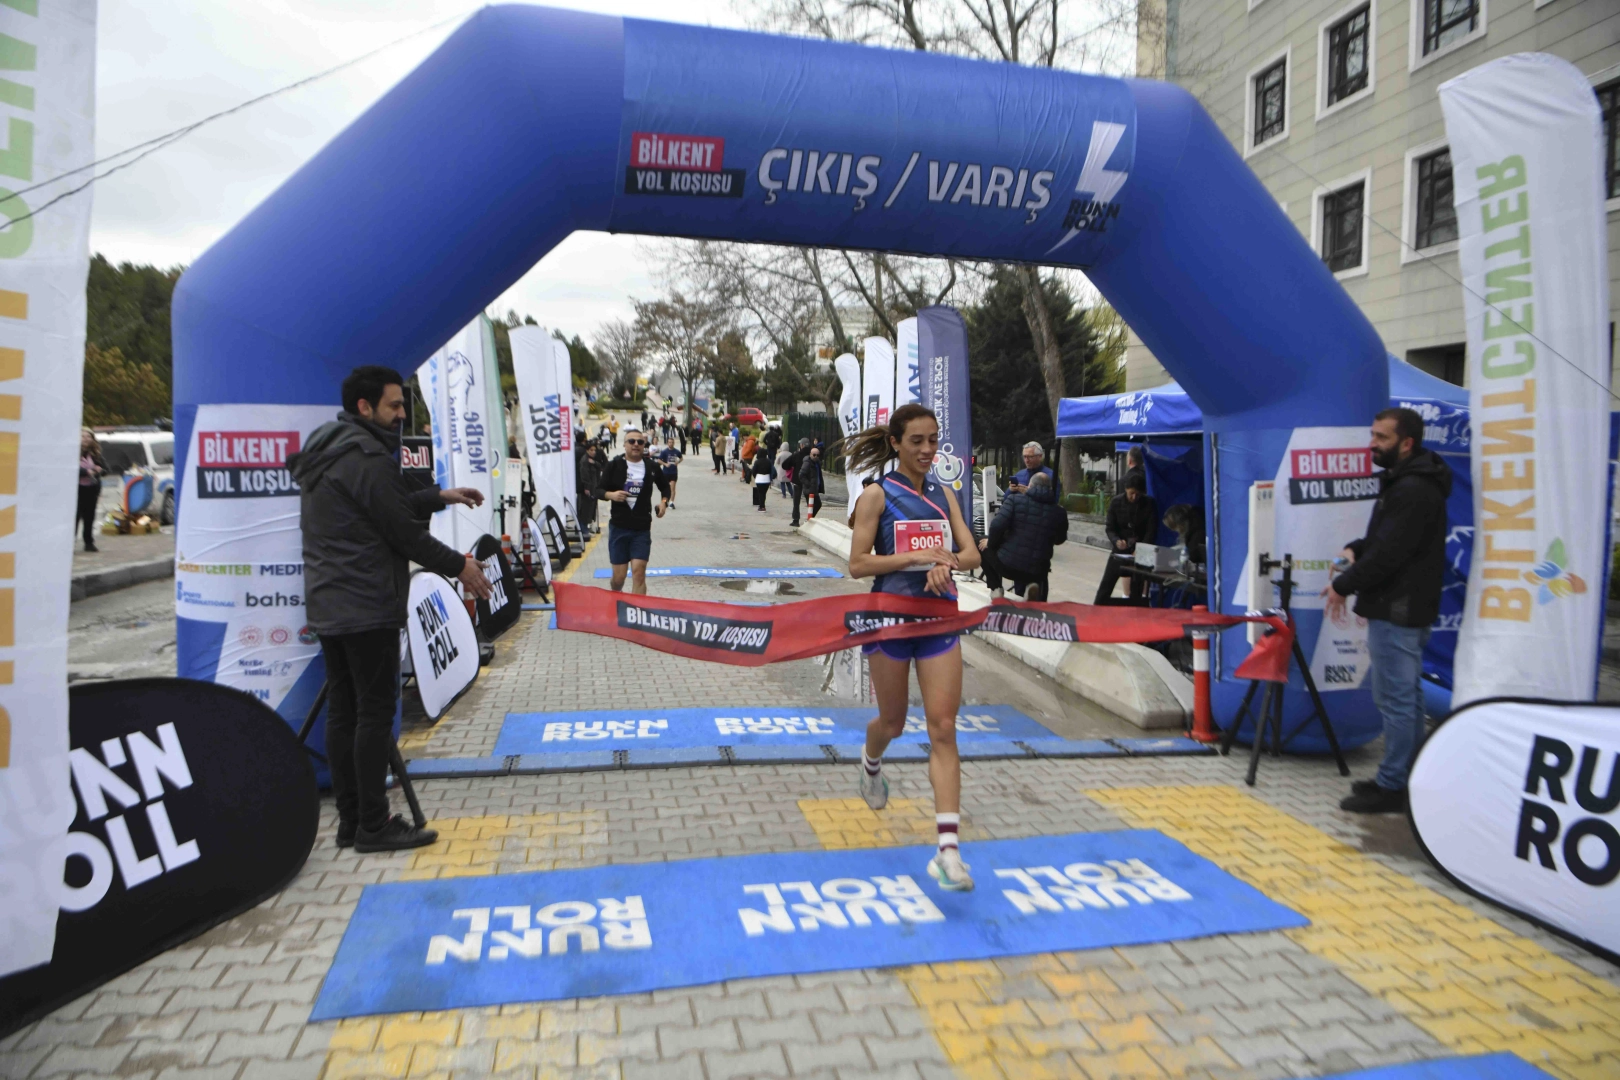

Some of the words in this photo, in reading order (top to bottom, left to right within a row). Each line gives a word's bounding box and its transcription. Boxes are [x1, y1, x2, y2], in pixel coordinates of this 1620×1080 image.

[638, 134, 715, 169] BİLKENT
[636, 170, 664, 190] YOL
[670, 173, 733, 195] KOŞUSU
[758, 148, 881, 212] ÇIKIŞ
[928, 160, 1055, 226] VARIŞ
[1061, 212, 1108, 233] ROLL
[203, 432, 289, 463] BİLKENT
[402, 446, 431, 468] Bull
[1298, 450, 1366, 475] BİLKENT
[204, 470, 235, 493] YOL
[1299, 480, 1329, 499] YOL
[910, 535, 942, 550] 9005
[626, 606, 688, 635] BİLKENT
[692, 620, 719, 642] YOL
[717, 626, 770, 650] KOŞUSU
[427, 626, 459, 680] ROLL
[541, 728, 661, 742] ROLL
[717, 724, 833, 735] ROLL
[992, 858, 1164, 890] ROLL
[742, 874, 924, 906] ROLL
[451, 895, 648, 933] ROLL
